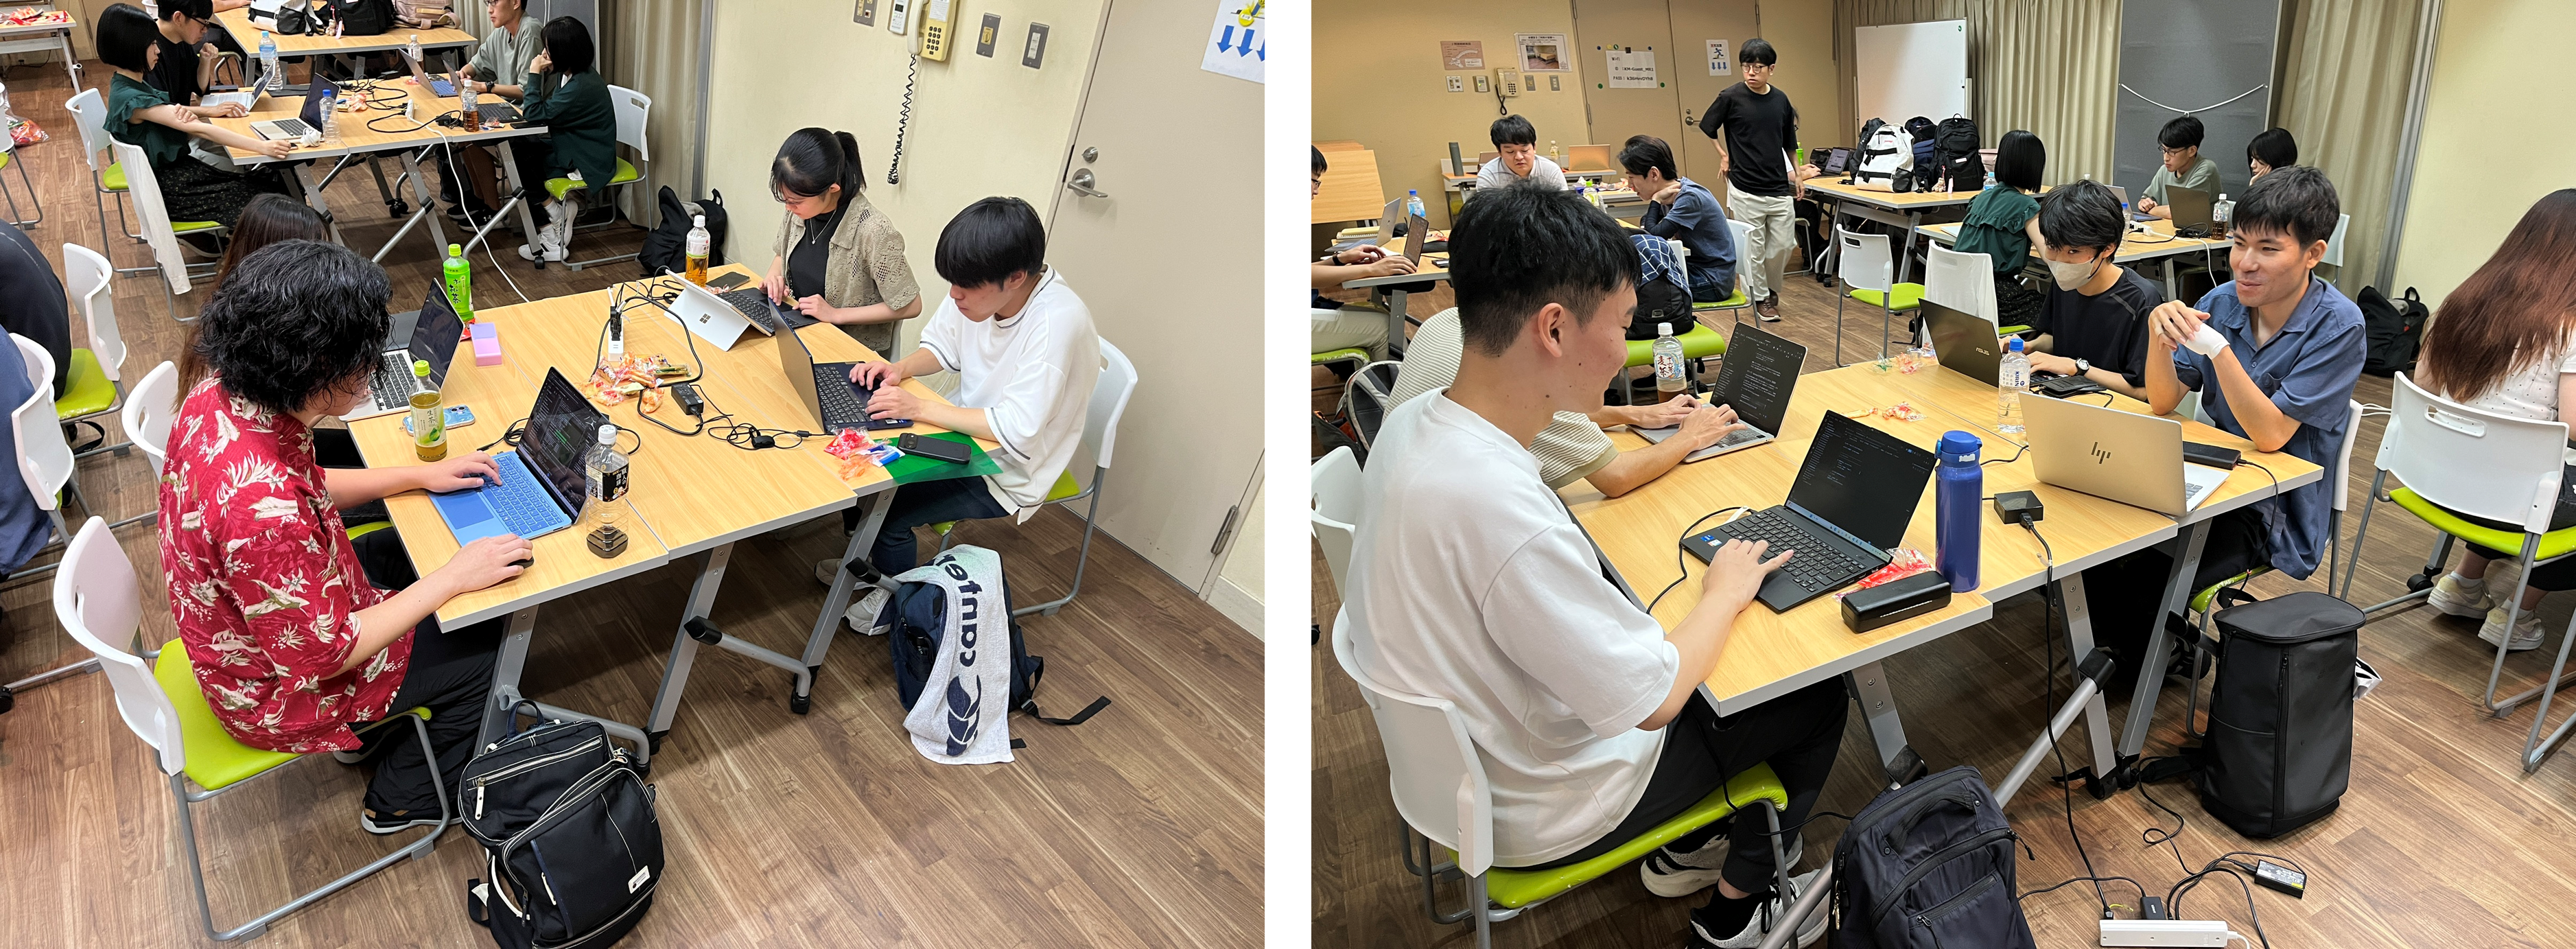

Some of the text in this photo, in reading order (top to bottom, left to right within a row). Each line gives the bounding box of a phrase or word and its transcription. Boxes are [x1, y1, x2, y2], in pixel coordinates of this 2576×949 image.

[1657, 355, 1670, 377] 麦茶
[427, 410, 435, 423] 生茶
[616, 473, 622, 487] 珈琲
